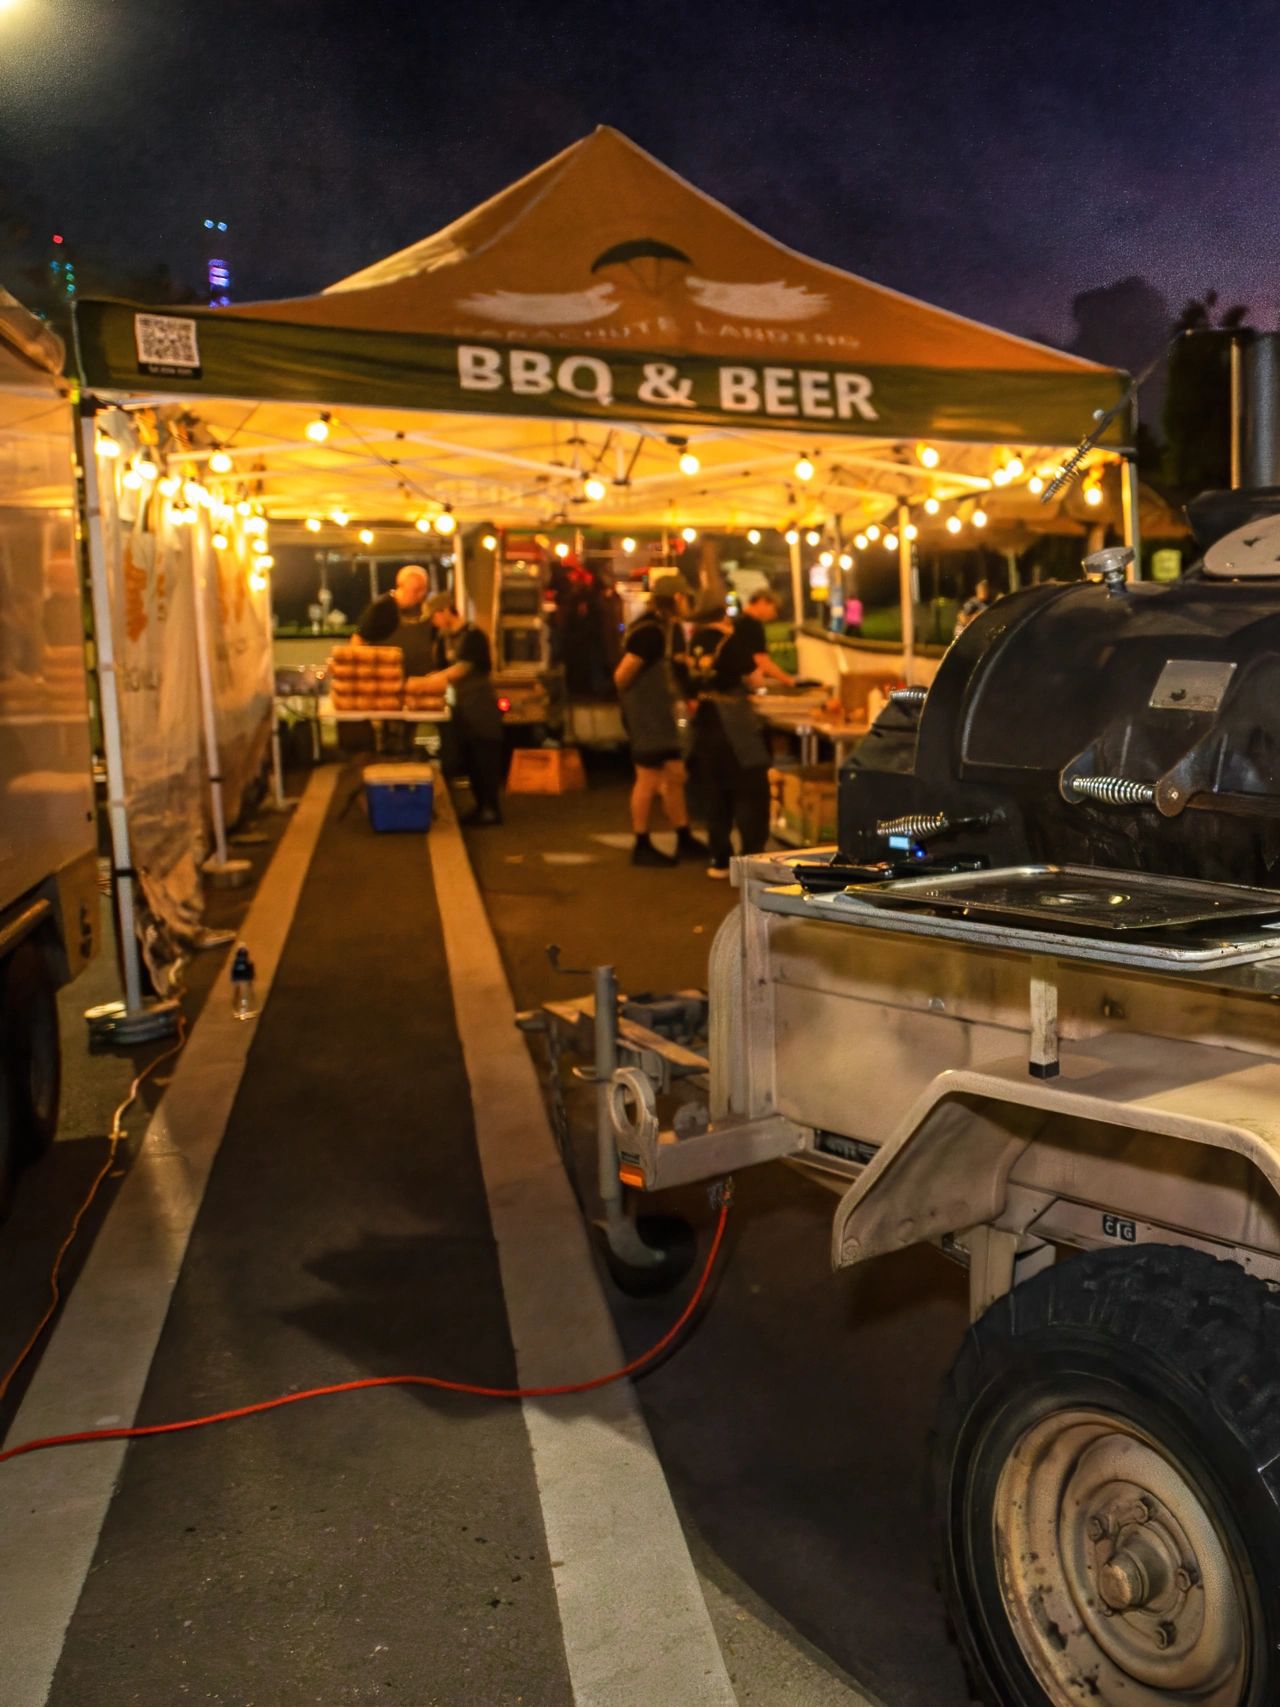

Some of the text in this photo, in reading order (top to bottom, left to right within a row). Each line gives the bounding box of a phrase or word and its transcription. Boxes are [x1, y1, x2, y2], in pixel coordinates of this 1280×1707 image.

[457, 345, 880, 420] BBQ & BEER
